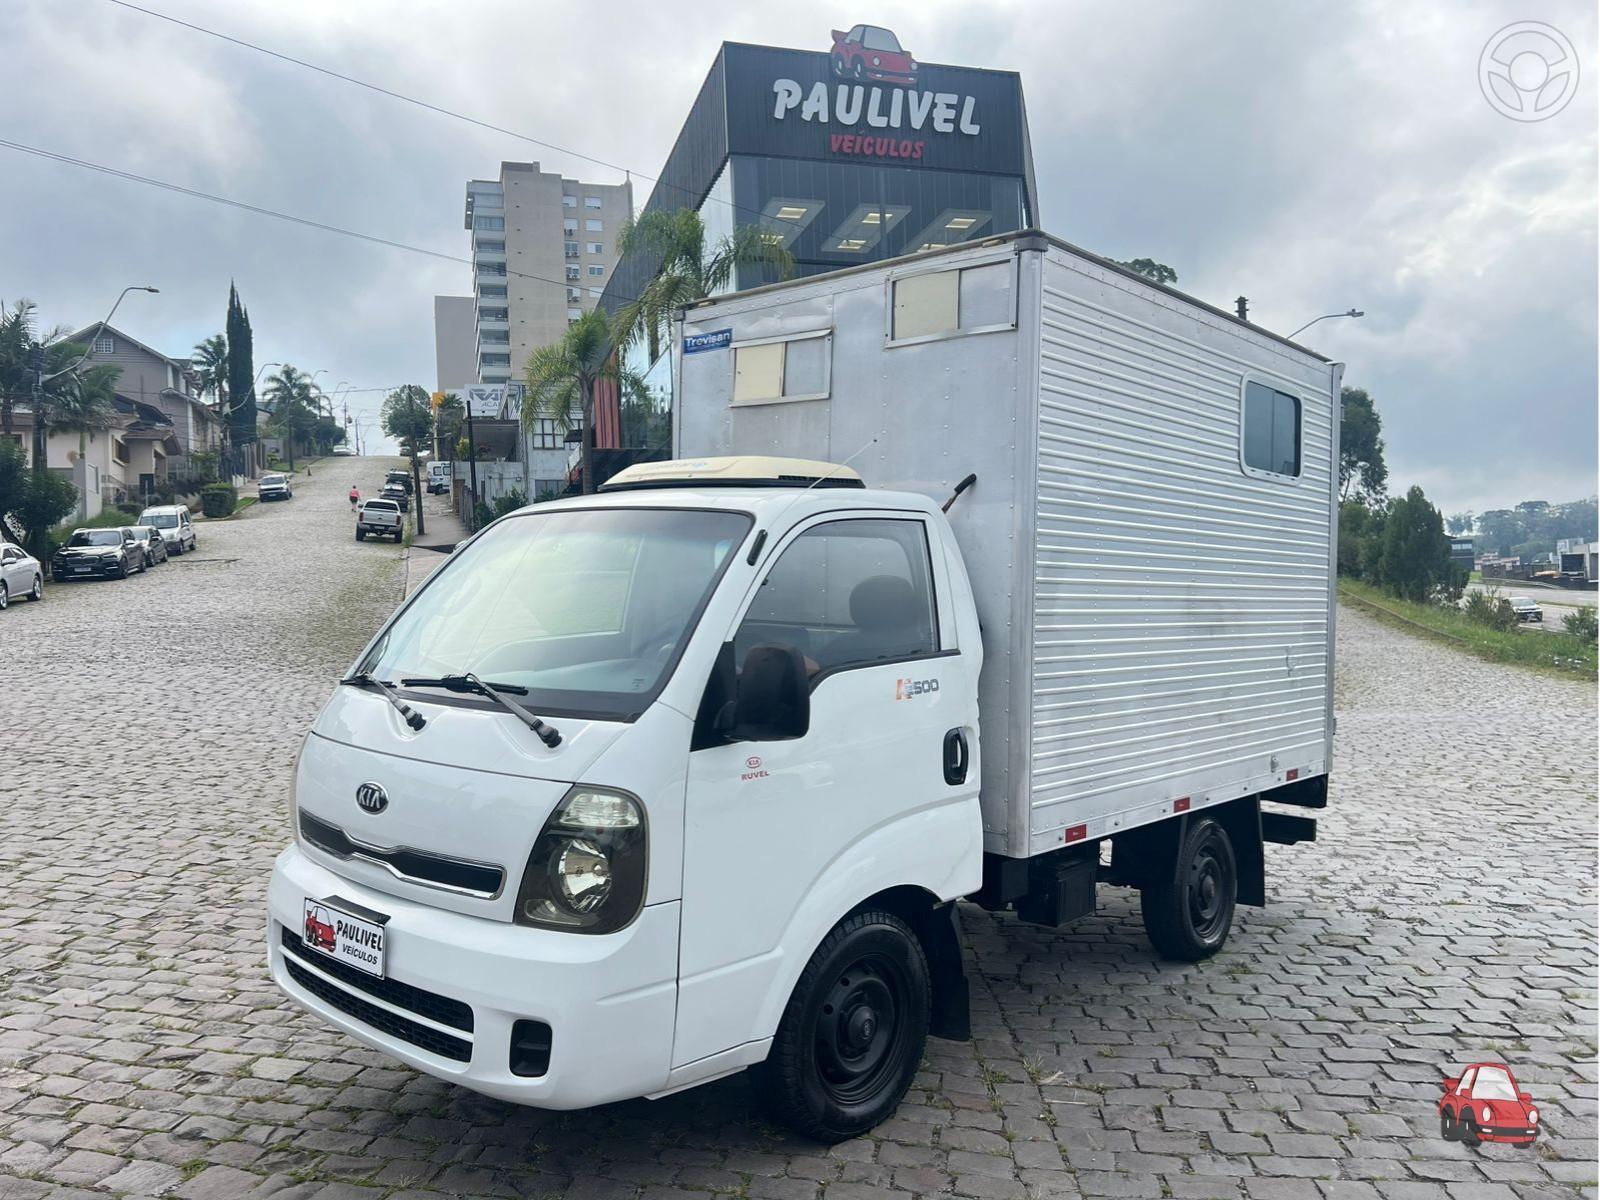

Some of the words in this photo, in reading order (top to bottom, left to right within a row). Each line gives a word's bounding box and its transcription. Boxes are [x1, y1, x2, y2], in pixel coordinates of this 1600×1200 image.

[773, 78, 981, 136] PAULIVEL
[685, 332, 730, 347] Trevisan
[741, 770, 770, 781] RUVEL
[357, 786, 381, 809] KIA
[336, 919, 382, 952] PAULIVEL
[342, 943, 378, 965] VEÍCULOS
